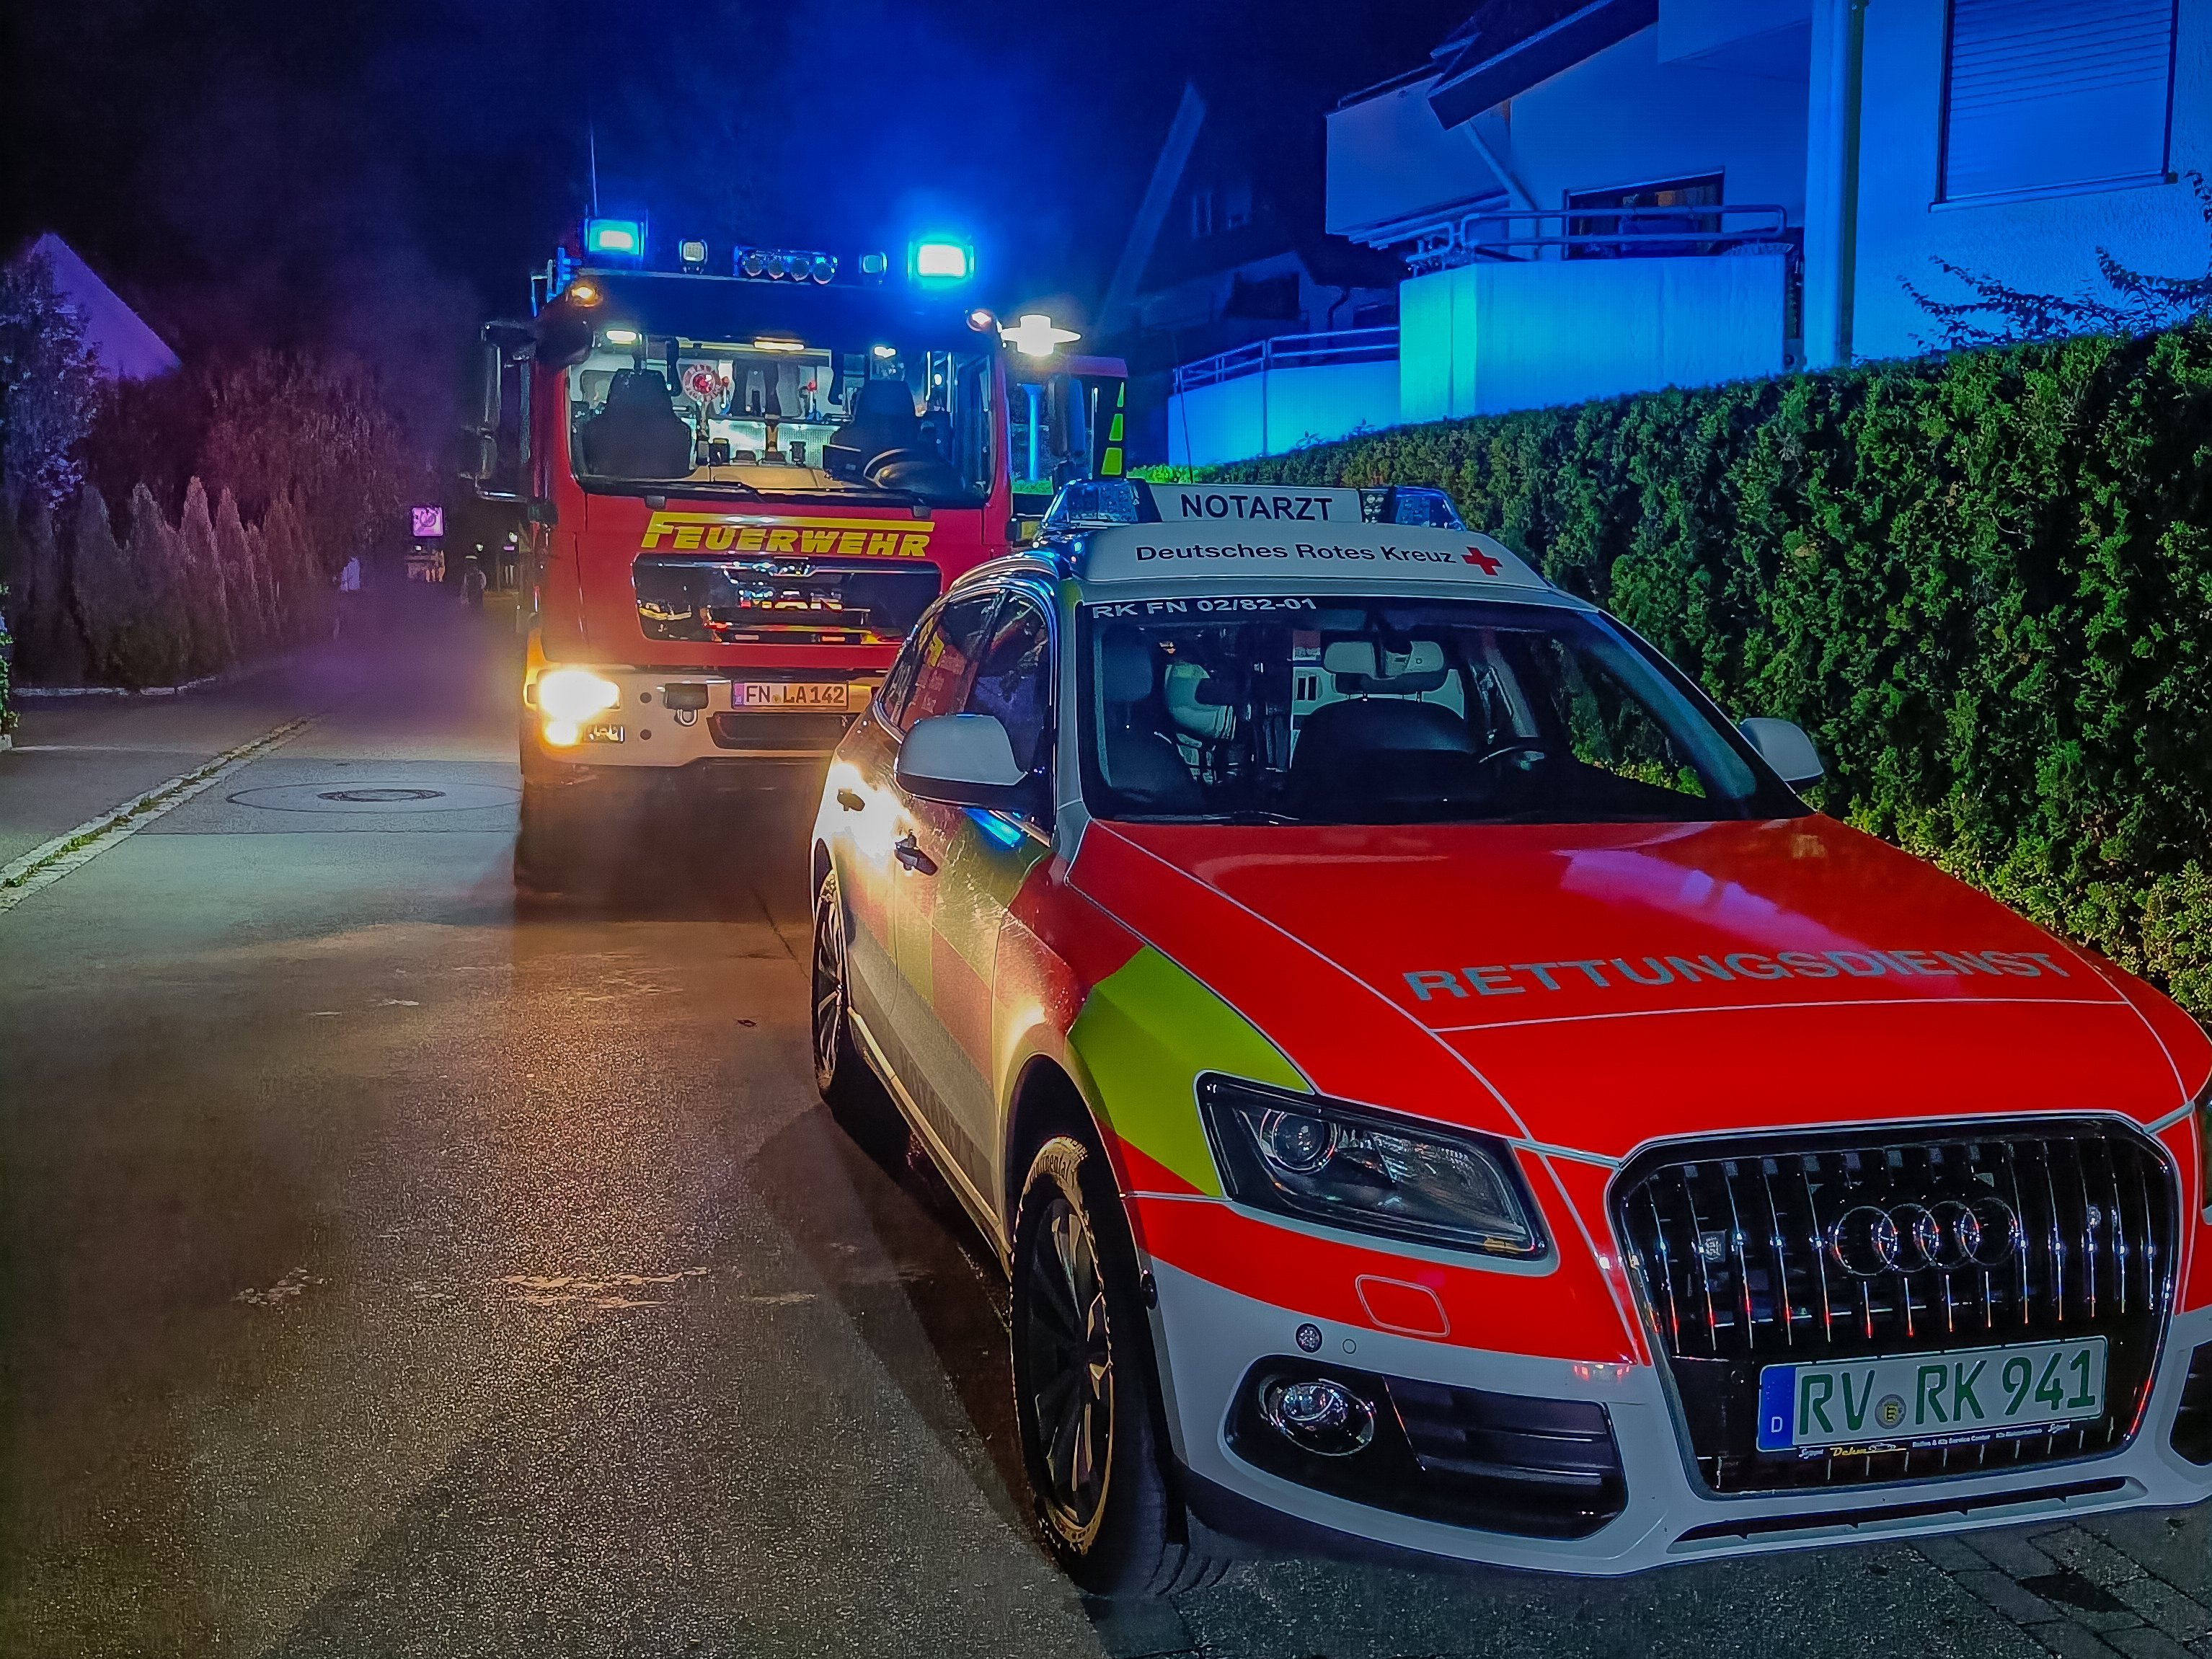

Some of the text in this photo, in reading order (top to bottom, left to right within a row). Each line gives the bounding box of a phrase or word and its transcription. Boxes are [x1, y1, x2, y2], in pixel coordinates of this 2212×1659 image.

[1180, 493, 1333, 521] NOTARZT
[640, 511, 936, 557] FEUERWEHR
[1136, 543, 1457, 564] Deutsches Rotes Kreuz
[738, 588, 844, 612] MAN
[1092, 597, 1317, 619] RK FN 02/82-01
[746, 686, 771, 703] FN
[1402, 950, 2071, 1001] RETTUNGSDIENST
[1799, 1349, 2096, 1435] RV RK 941
[1771, 1416, 1783, 1433] D
